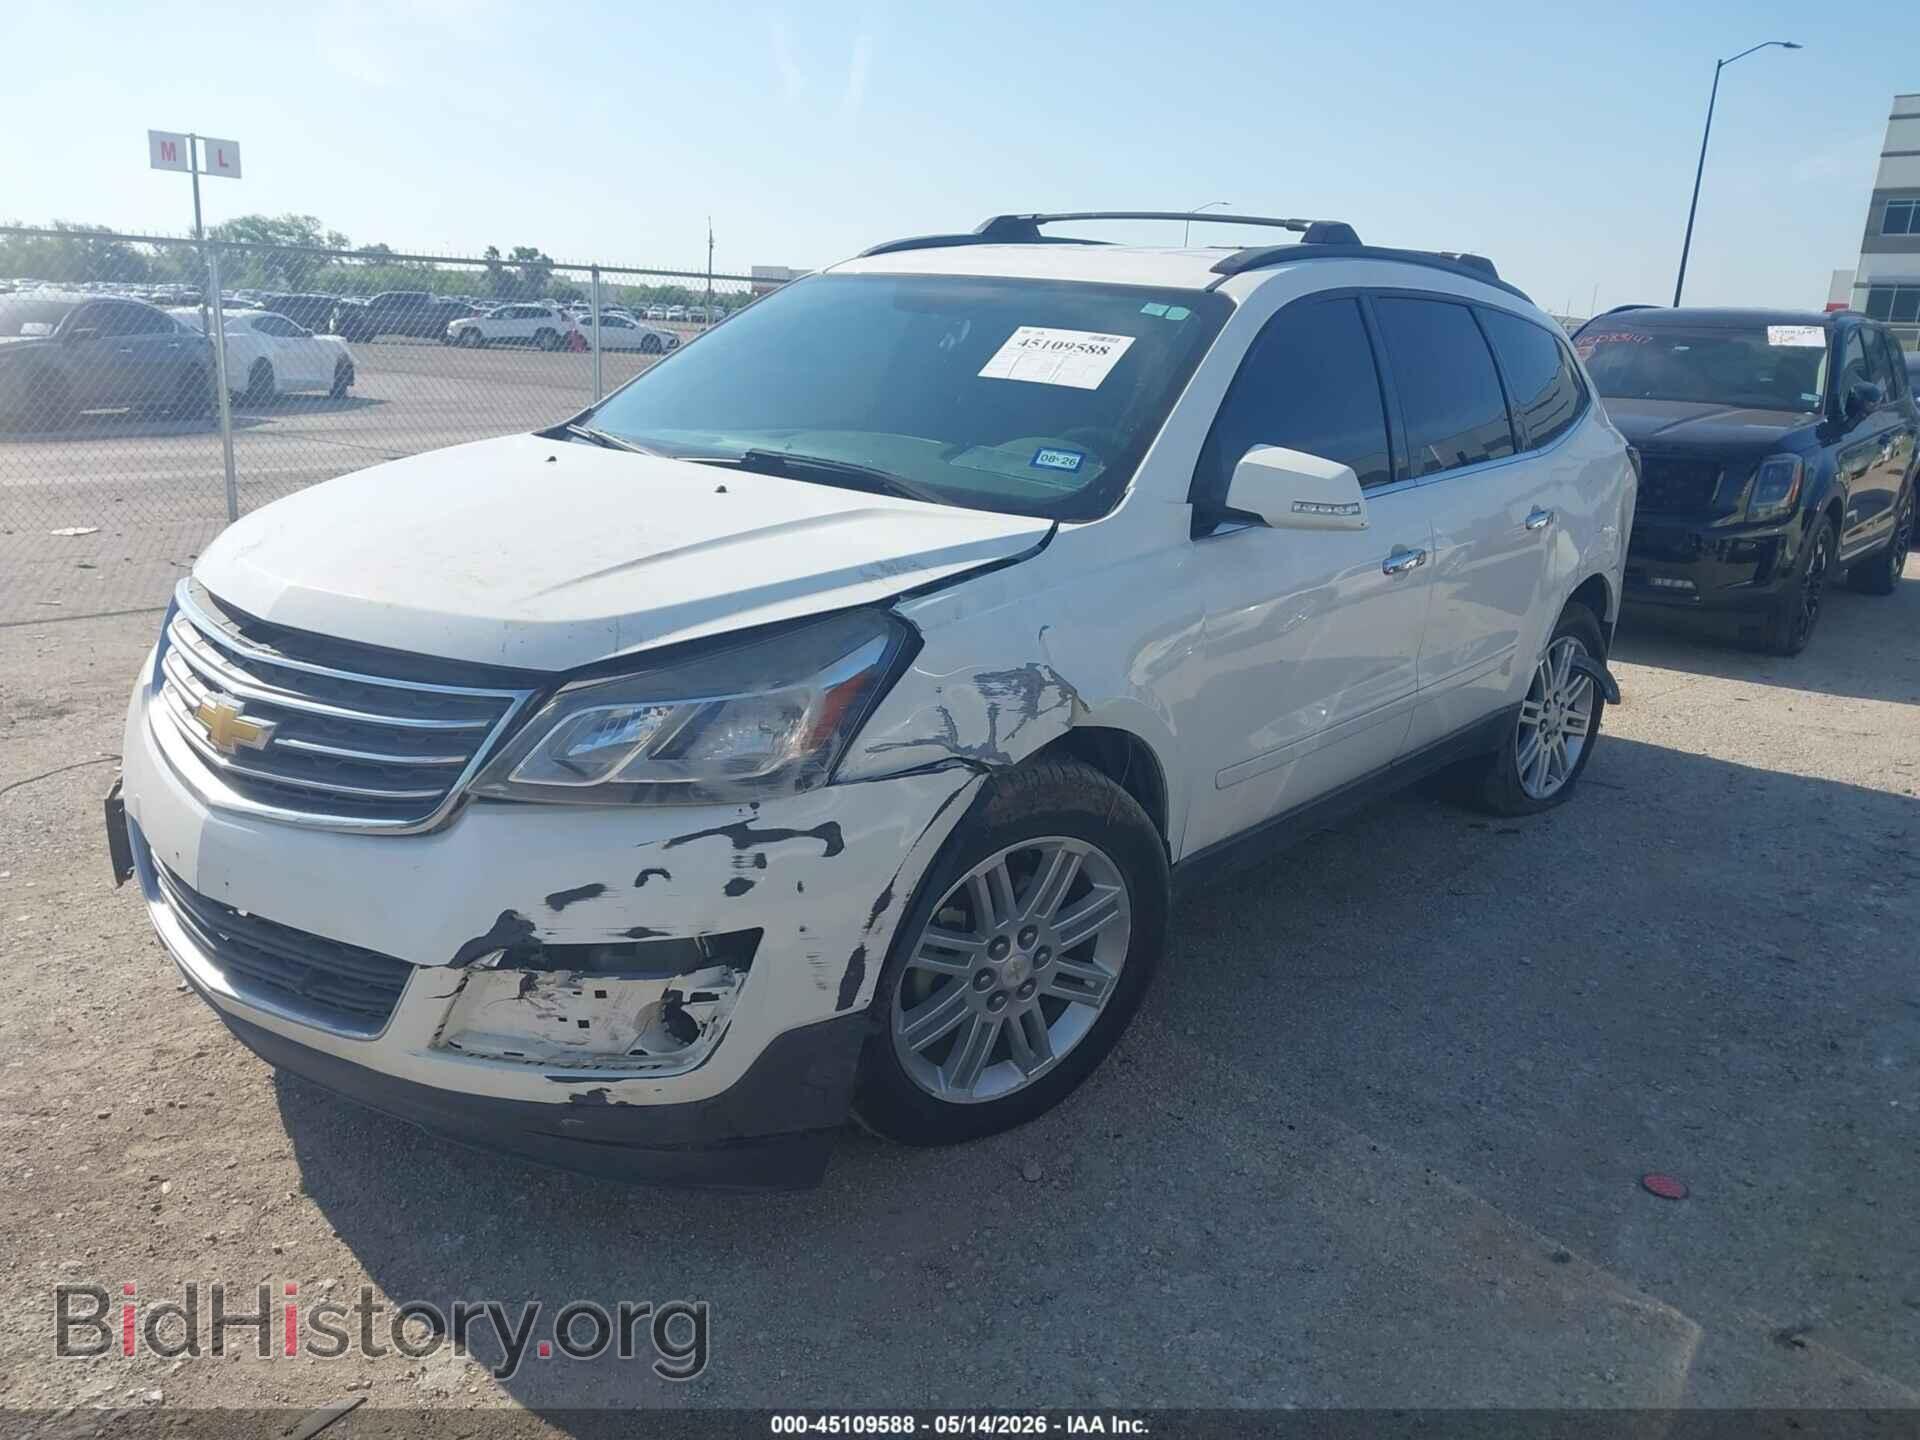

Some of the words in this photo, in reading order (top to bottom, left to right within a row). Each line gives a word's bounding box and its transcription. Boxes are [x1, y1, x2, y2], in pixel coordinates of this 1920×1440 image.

[161, 142, 176, 161] M
[218, 149, 229, 167] L
[1017, 338, 1111, 355] 45109588
